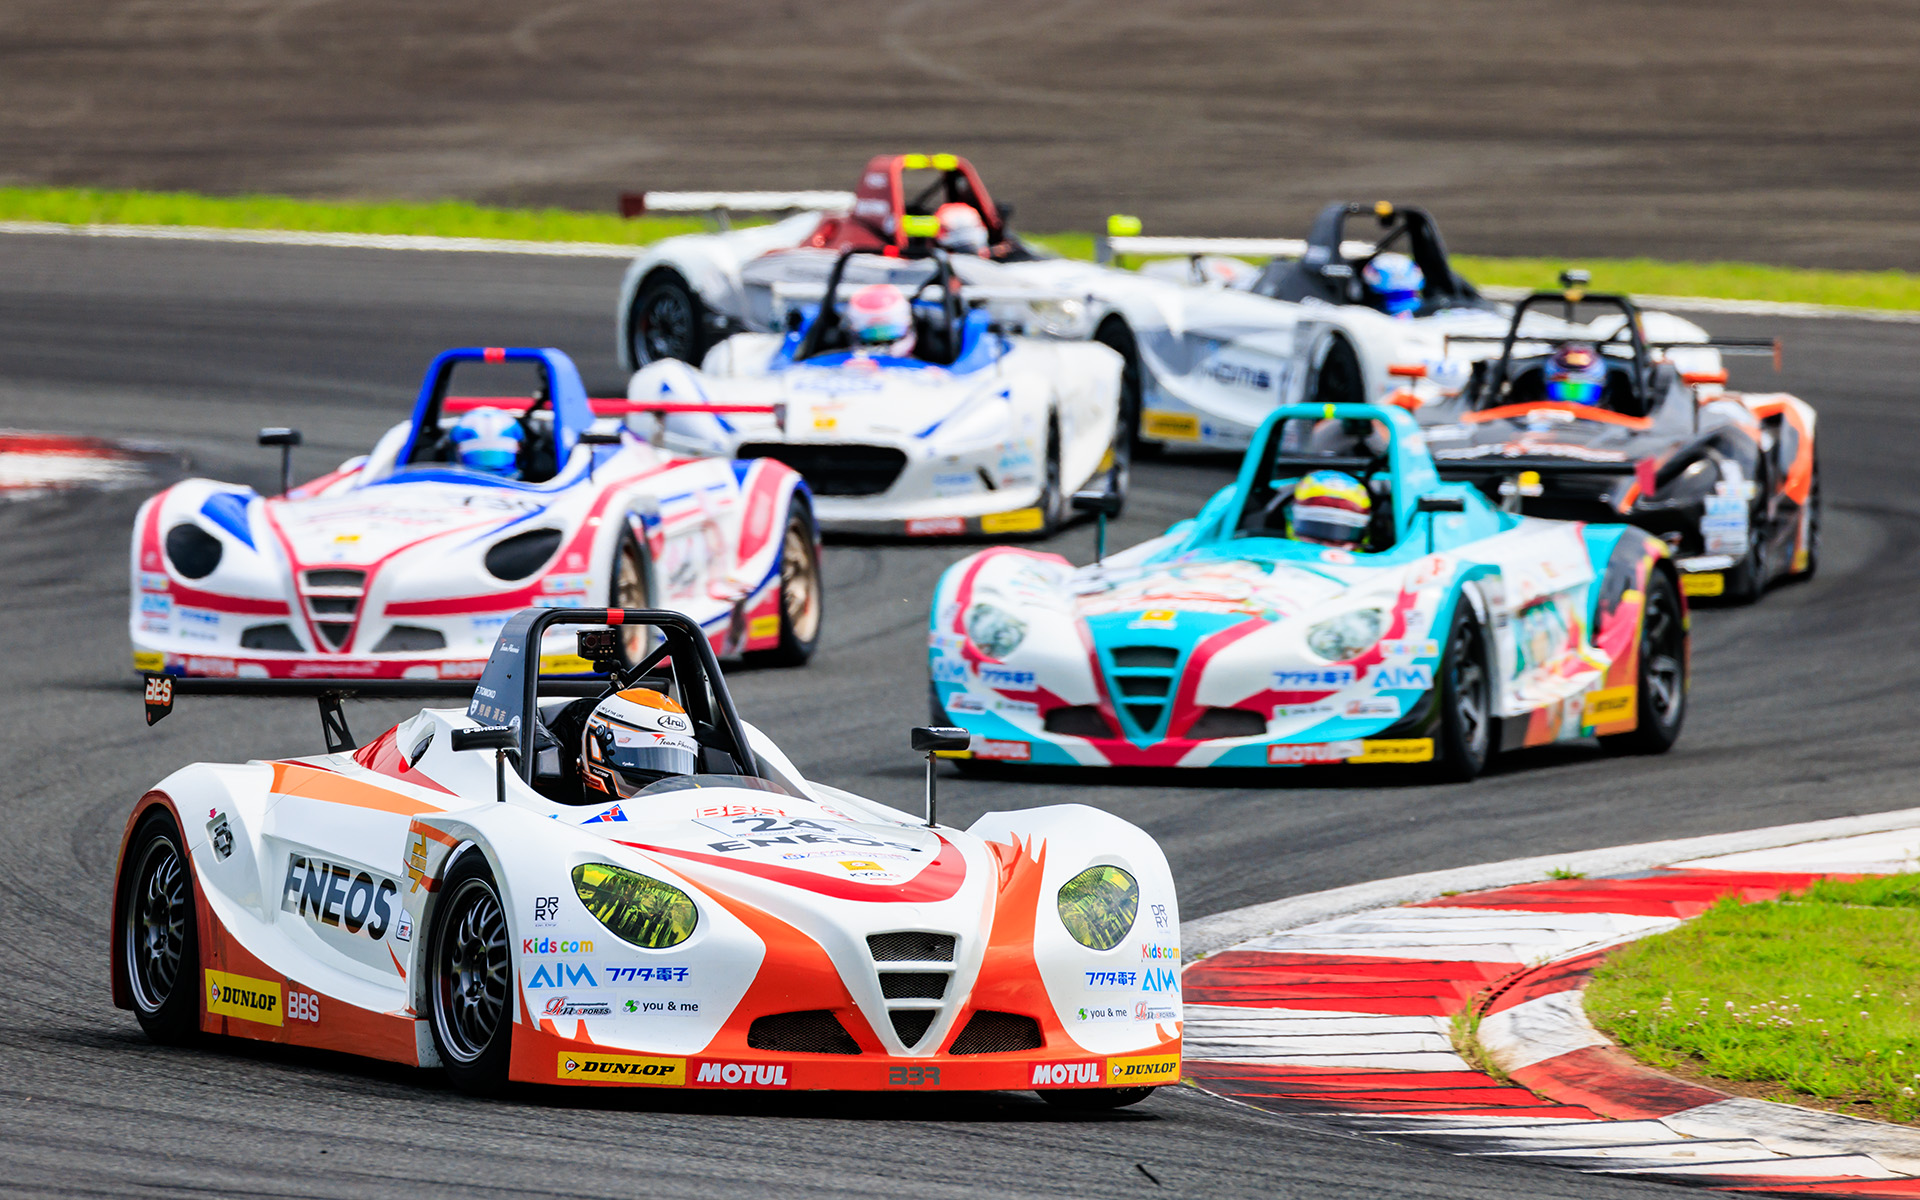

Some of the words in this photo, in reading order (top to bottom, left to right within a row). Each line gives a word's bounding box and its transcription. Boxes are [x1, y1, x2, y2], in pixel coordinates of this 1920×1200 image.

[145, 678, 171, 702] BBS
[664, 716, 684, 728] Arai
[696, 804, 786, 818] BBS
[732, 817, 837, 832] 24
[707, 833, 922, 852] ENEOS
[281, 852, 397, 941] ENEOS
[535, 897, 559, 909] DR
[535, 909, 559, 921] RY
[523, 937, 557, 954] Kids
[560, 940, 594, 953] com
[1142, 943, 1162, 959] Kids
[1163, 947, 1181, 959] com
[527, 963, 599, 988] AIM
[606, 967, 689, 982] フクダ電子
[1085, 971, 1137, 986] フクダ電子
[1142, 967, 1180, 992] AIM
[222, 986, 276, 1011] DUNLOP
[288, 991, 319, 1022] BBS
[643, 1002, 664, 1012] you
[667, 1001, 676, 1011] &
[680, 1003, 699, 1011] me
[1090, 1008, 1105, 1019] you
[1107, 1008, 1114, 1016] &
[1115, 1009, 1127, 1017] me
[582, 1061, 675, 1076] DUNLOP
[697, 1063, 787, 1085] MOTUL
[1032, 1063, 1099, 1085] MOTUL
[1124, 1062, 1177, 1076] DUNLOP
